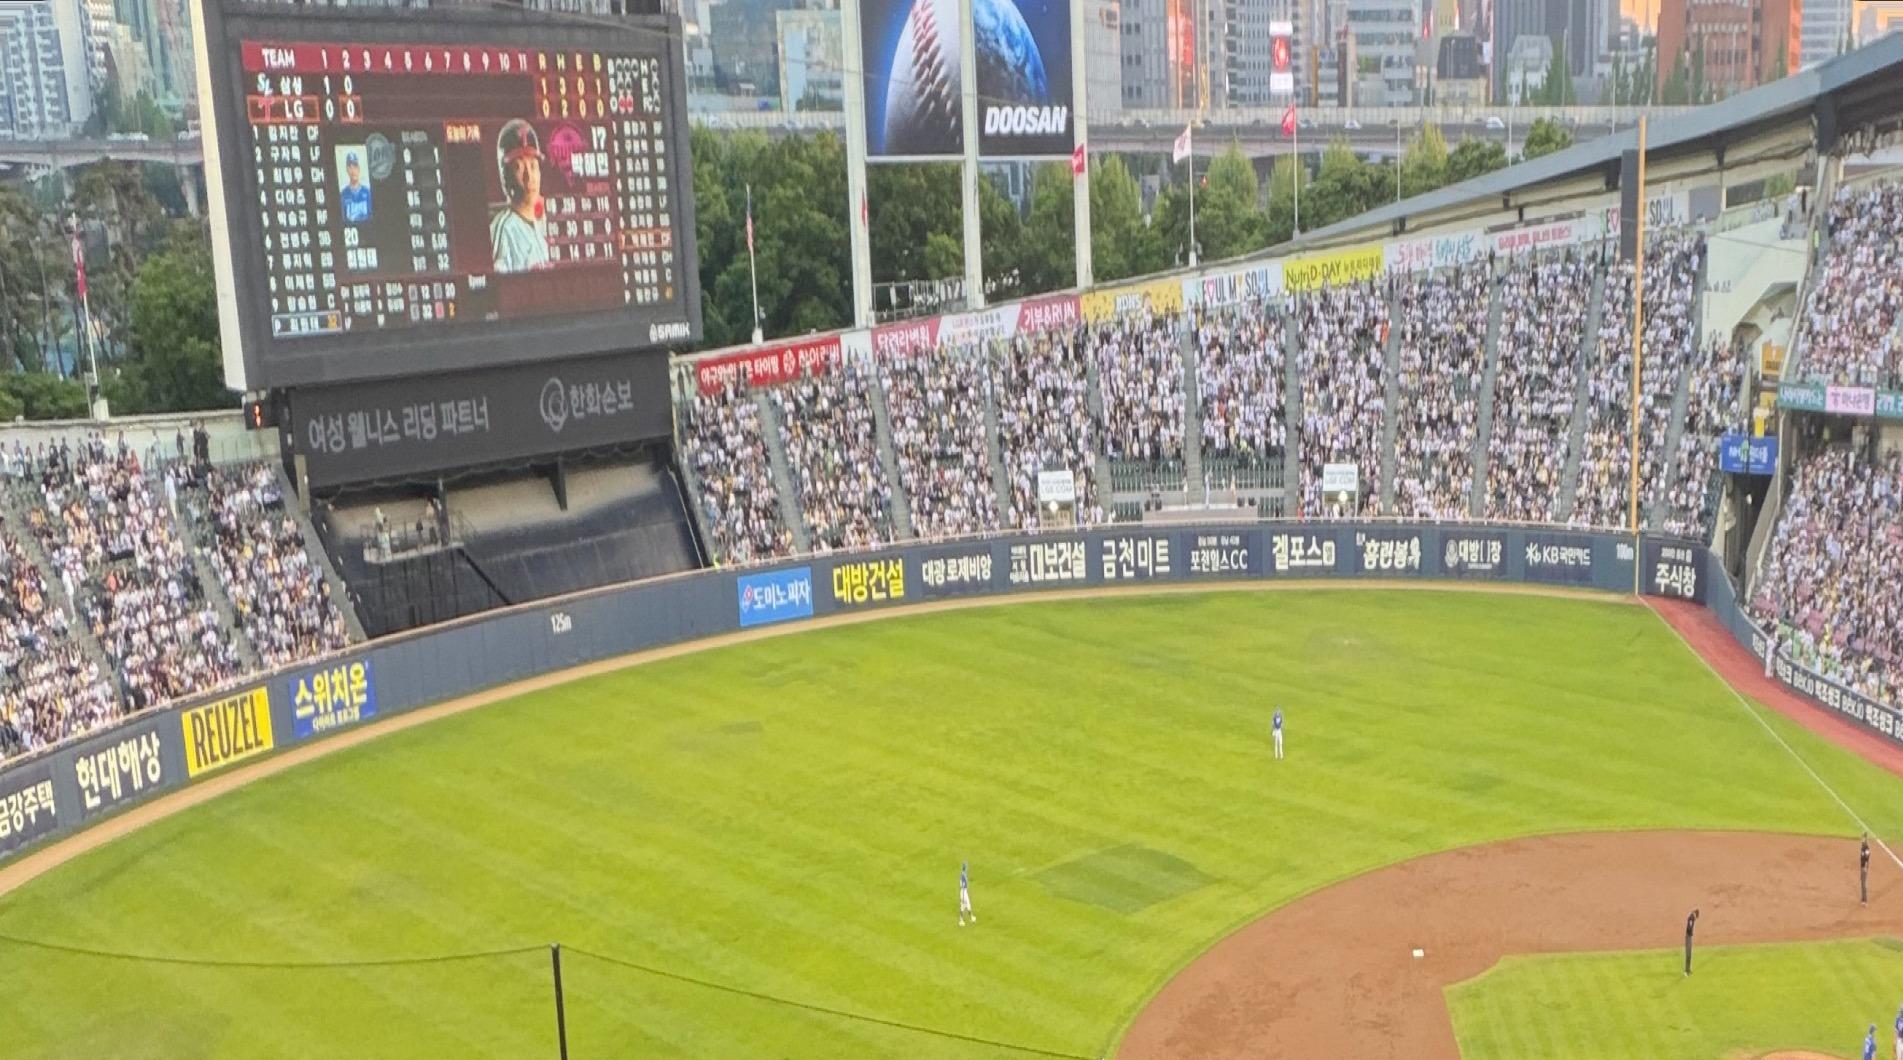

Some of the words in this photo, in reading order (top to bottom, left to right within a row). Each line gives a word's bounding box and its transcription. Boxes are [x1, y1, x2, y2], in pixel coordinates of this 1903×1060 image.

[262, 48, 295, 69] TEAM
[342, 49, 350, 70] 2
[363, 50, 371, 71] 3
[384, 51, 392, 70] 4
[404, 51, 412, 71] 5
[482, 52, 489, 72] 9
[498, 52, 510, 72] 10
[518, 53, 528, 72] 11
[556, 52, 565, 71] H
[344, 75, 352, 94] 0
[577, 77, 585, 96] 0
[284, 99, 304, 121] LG
[326, 99, 334, 120] 0
[346, 99, 355, 120] 0
[543, 99, 549, 119] 0
[562, 99, 569, 119] 2
[579, 99, 586, 119] 0
[597, 99, 604, 119] 0
[984, 104, 1067, 137] DOOSAN
[591, 127, 606, 151] 17
[255, 146, 262, 163] 2
[571, 152, 609, 177] 박해민
[436, 189, 443, 206] 0
[344, 227, 358, 247] 20
[605, 218, 611, 236] 0
[438, 253, 449, 271] 32
[604, 242, 613, 258] 11
[445, 282, 455, 300] 20
[1245, 269, 1271, 297] SOUL
[327, 293, 335, 310] C
[1025, 301, 1076, 328] 기부&RUN
[754, 355, 780, 378] 타이밍
[569, 380, 634, 419] 한화손보
[308, 413, 346, 453] 여성
[346, 408, 401, 449] 웰니스
[402, 400, 437, 441] 리딩
[440, 396, 490, 436] 파트너
[922, 557, 945, 587] 대광
[946, 553, 992, 583] 로제비앙
[1030, 541, 1086, 582] 대보건설
[1102, 537, 1170, 579] 금천미트
[833, 558, 904, 604] 대방건설
[1655, 563, 1697, 598] 주식창
[753, 578, 810, 610] 도미노피자
[551, 614, 572, 634] 125m
[295, 662, 367, 720] 스위치온
[191, 694, 263, 769] REUZEL
[76, 731, 161, 809] 현대해상
